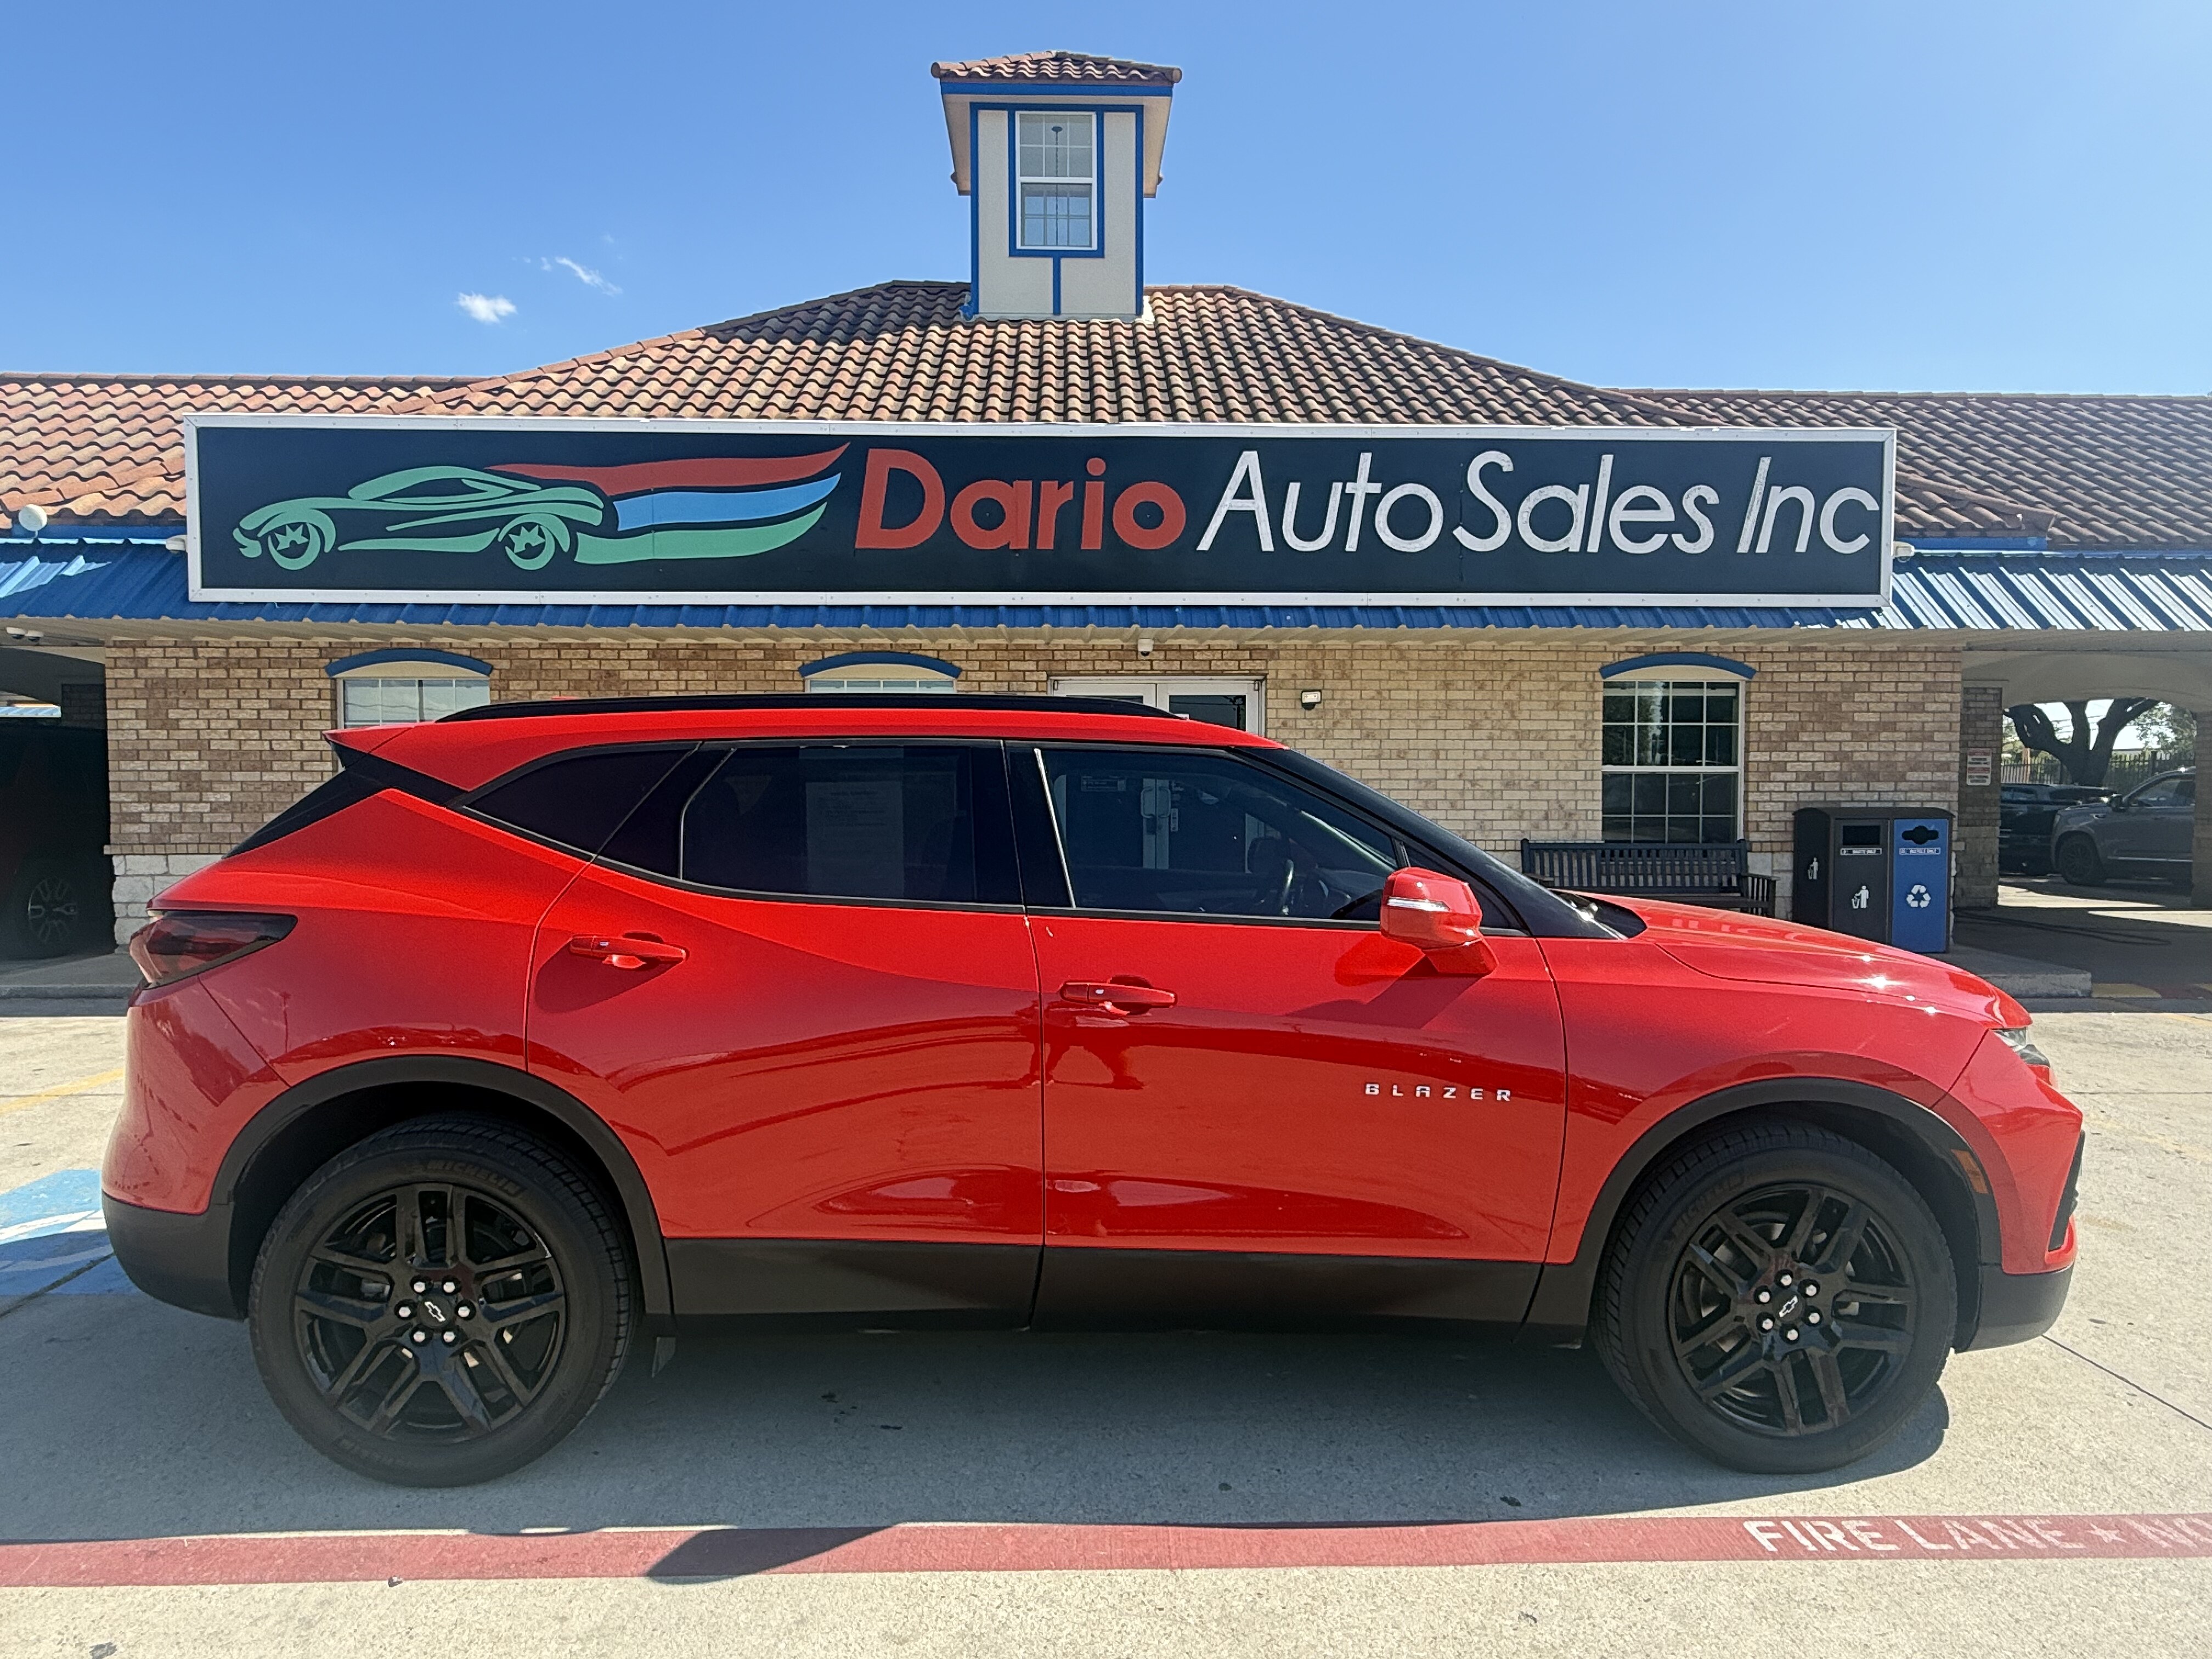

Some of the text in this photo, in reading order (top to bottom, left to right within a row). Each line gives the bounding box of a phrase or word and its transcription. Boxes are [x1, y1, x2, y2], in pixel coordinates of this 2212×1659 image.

[855, 448, 1880, 554] Dario Auto Sales Inc
[1364, 1082, 1511, 1102] BLAZER
[427, 1159, 521, 1195] MICHELIN
[1742, 1520, 1901, 1551] FIRE
[1893, 1519, 2087, 1550] LANE
